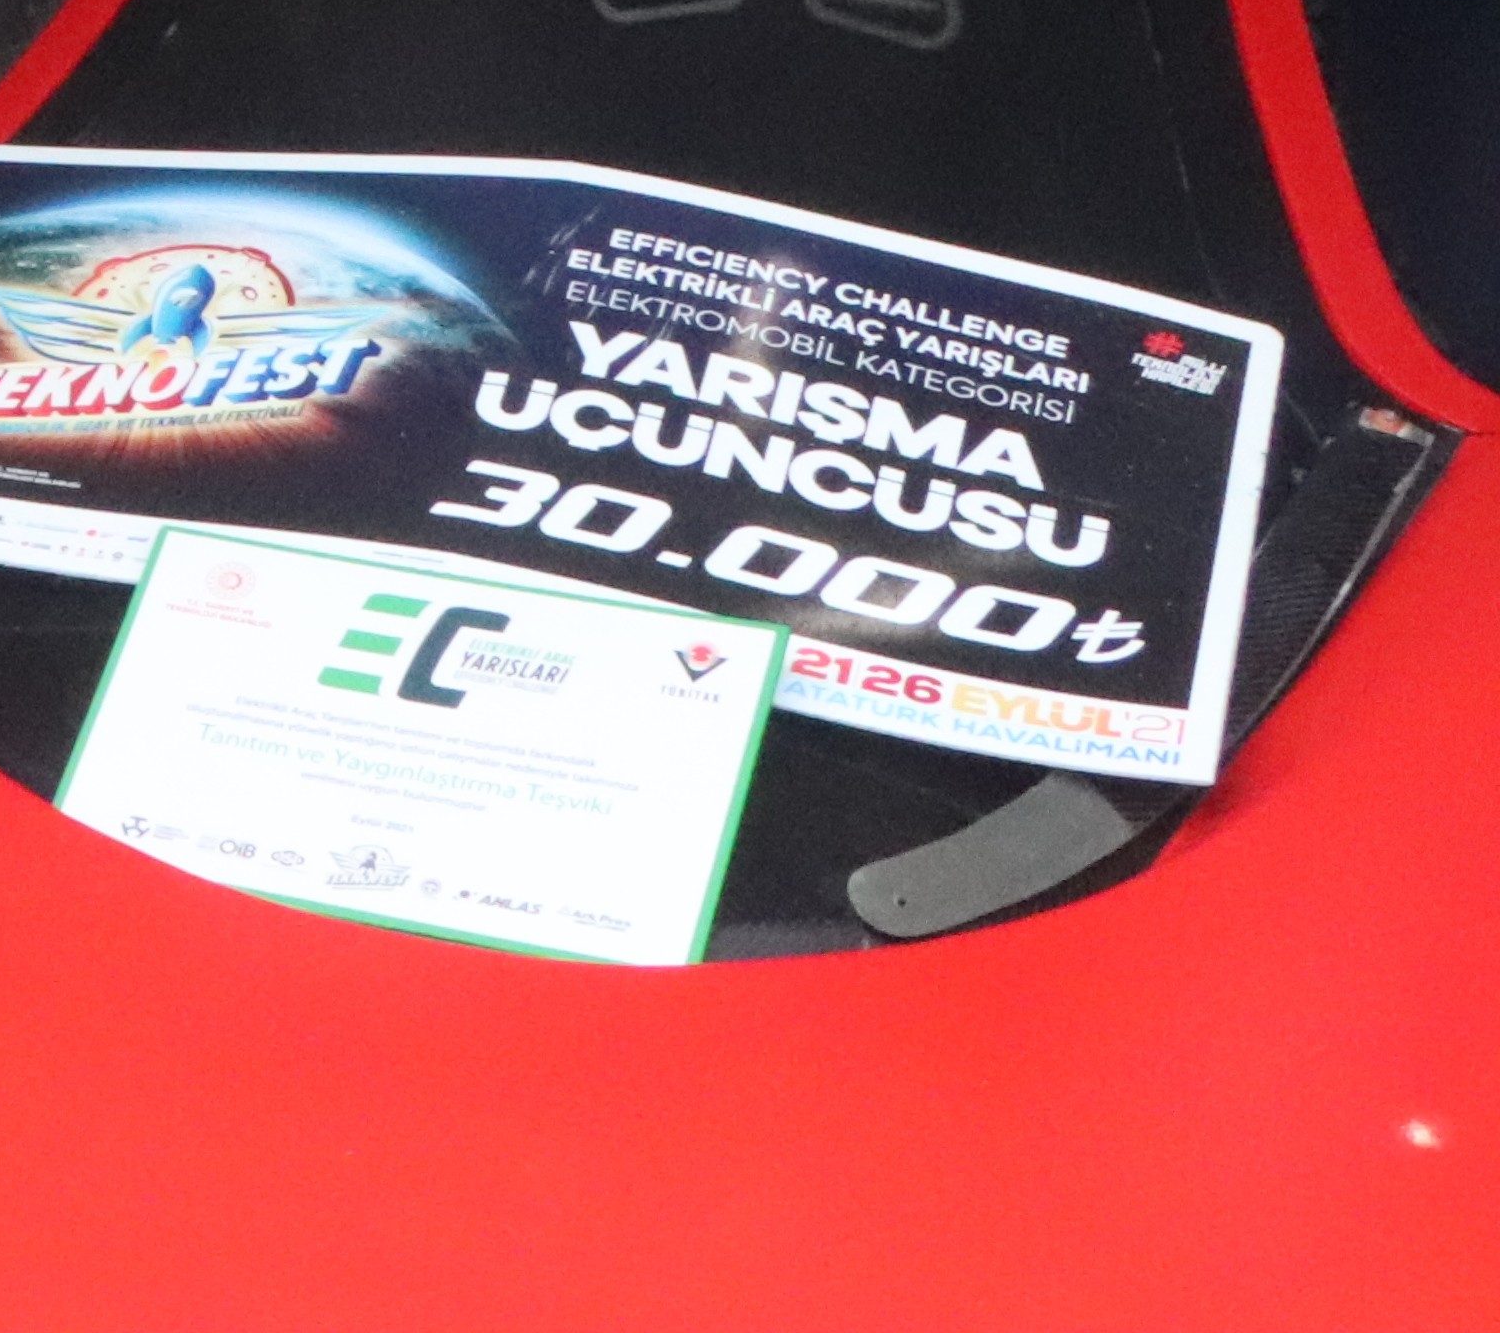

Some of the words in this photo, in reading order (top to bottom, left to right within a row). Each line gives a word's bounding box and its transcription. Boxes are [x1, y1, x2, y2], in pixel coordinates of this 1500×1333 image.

[565, 280, 845, 367] ELEKTROMOBİL
[855, 349, 1078, 425] KATEGORİSİ
[566, 249, 776, 313] ELEKTRİKLİ
[780, 298, 888, 347] ARAÇ
[896, 326, 1091, 394] YARIŞLARI
[609, 228, 830, 296] EFFICIENCY
[834, 282, 1071, 360] CHALLENGE
[568, 320, 1045, 491] YARIŞMA
[790, 647, 853, 686] 21
[861, 663, 944, 705] 26
[200, 722, 289, 757] Tanıtım
[297, 746, 325, 764] ve
[335, 748, 517, 800] Yaygınlaştırma
[527, 782, 614, 816] Teşviki
